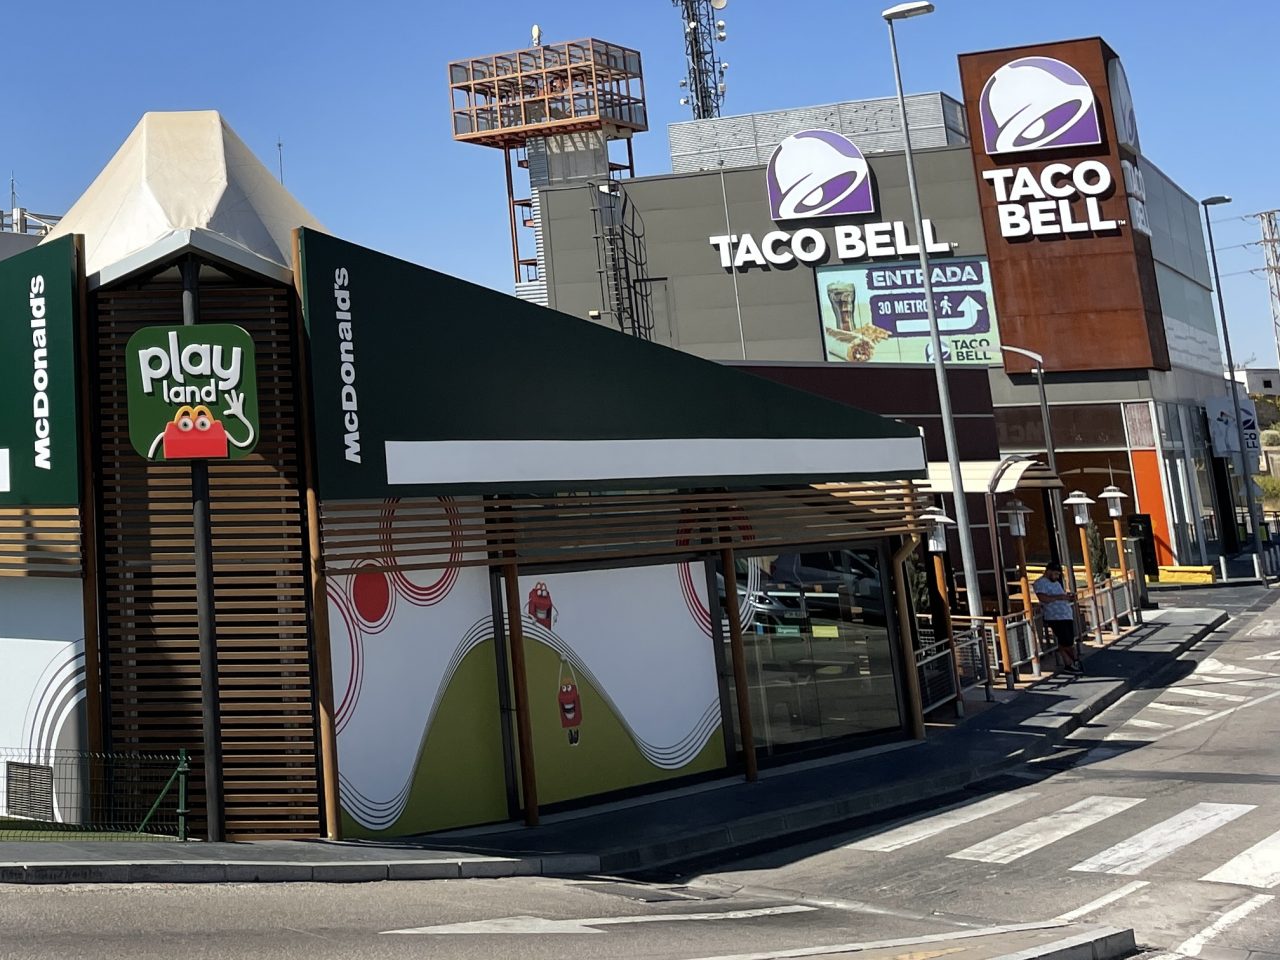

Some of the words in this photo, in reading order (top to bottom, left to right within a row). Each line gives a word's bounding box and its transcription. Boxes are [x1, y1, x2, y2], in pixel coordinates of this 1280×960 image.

[982, 160, 1111, 202] TACO
[998, 197, 1117, 238] BELL
[709, 228, 826, 268] TACO
[835, 219, 950, 259] BELL
[877, 301, 892, 315] 30
[894, 299, 937, 315] METRO
[29, 274, 52, 470] McDonald's
[138, 331, 242, 393] play
[334, 267, 362, 464] McDonald's
[956, 350, 992, 361] BELL
[163, 379, 216, 403] land
